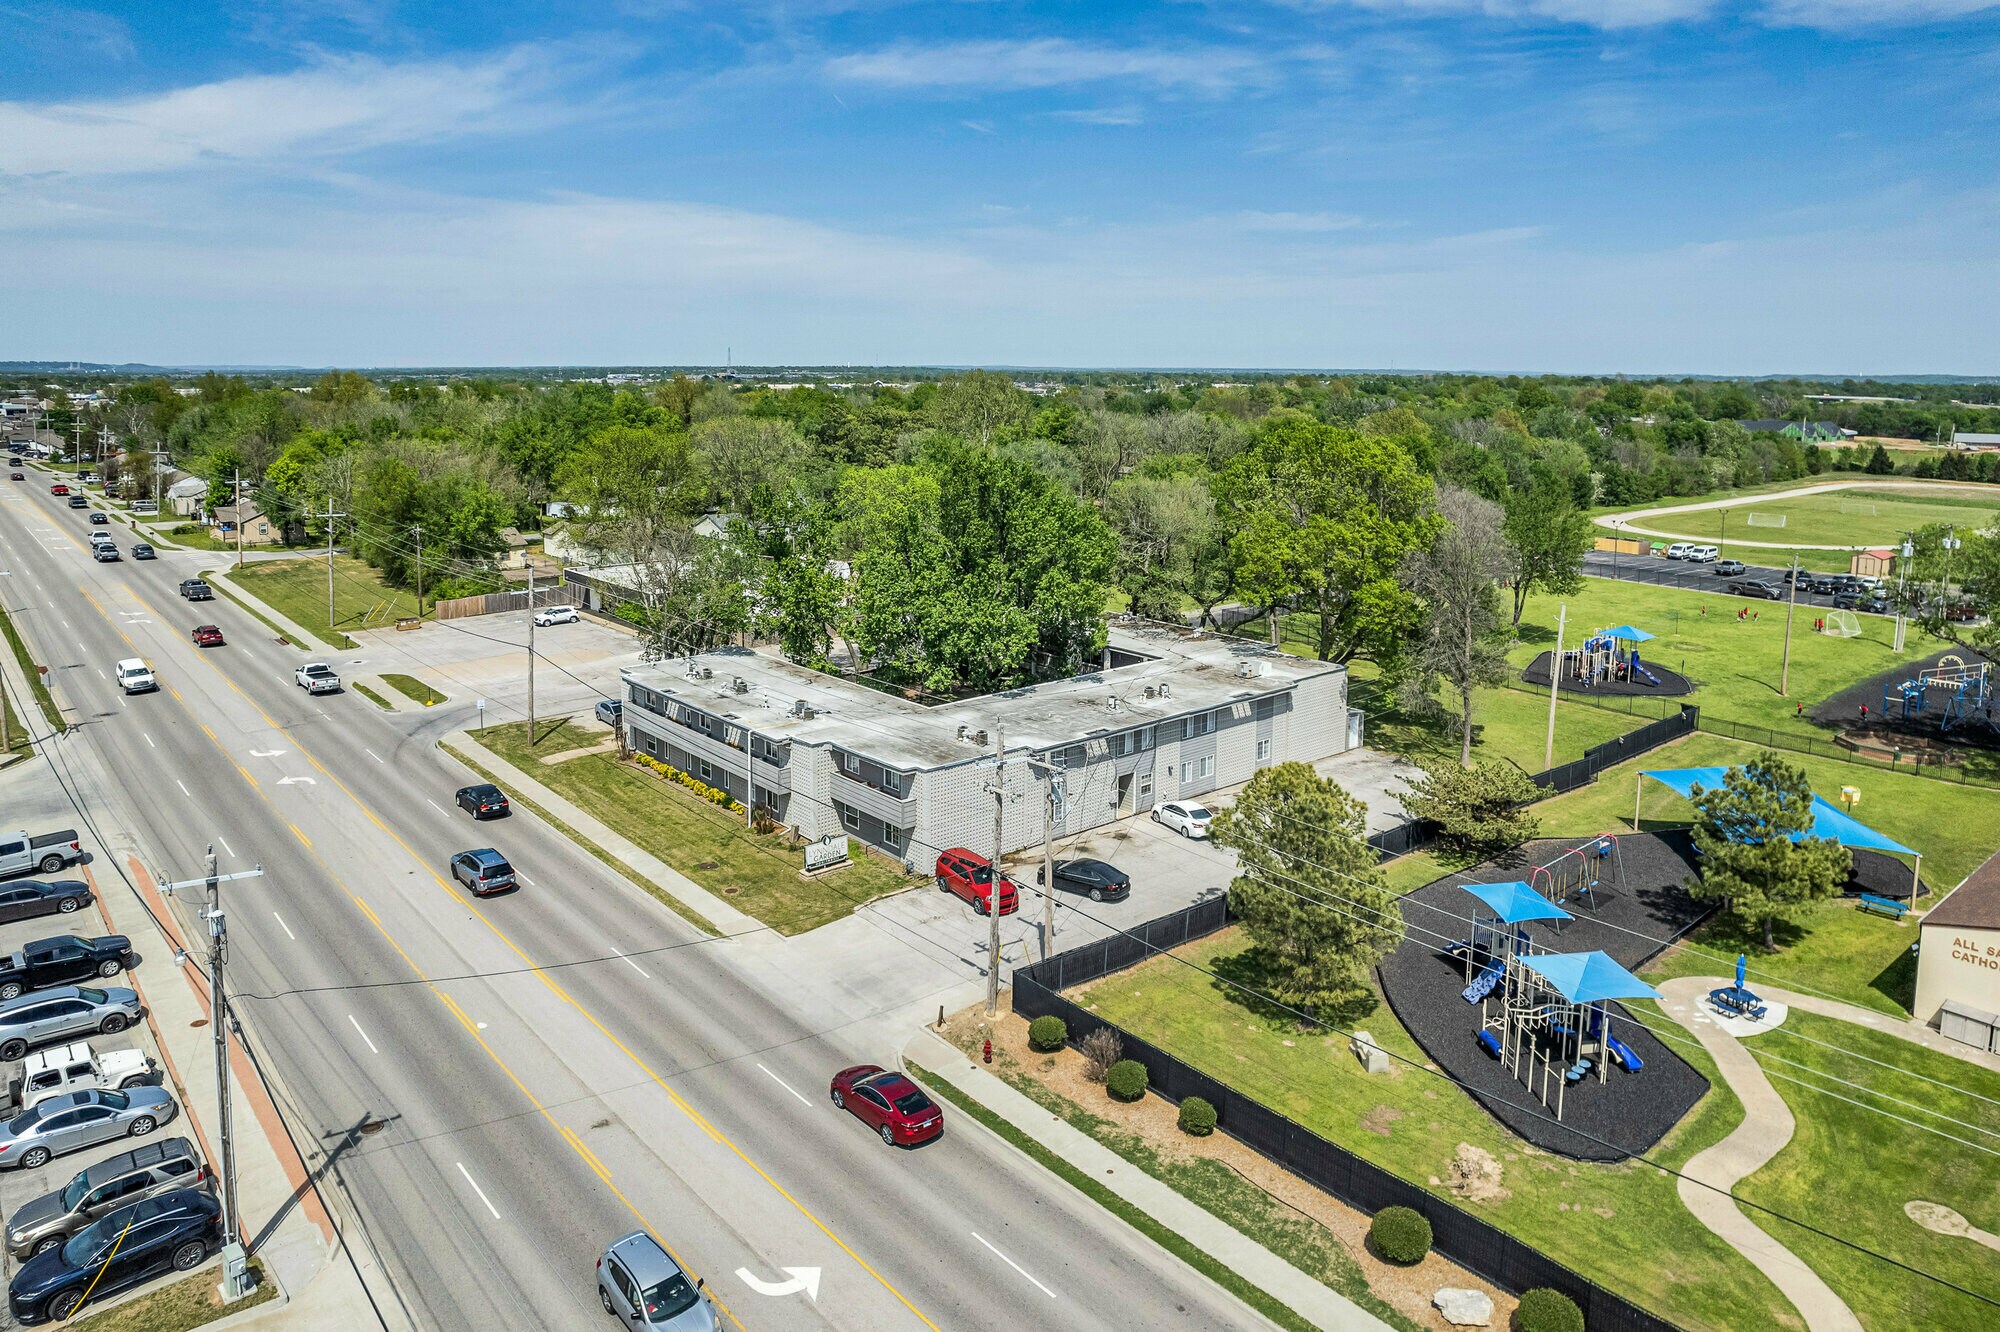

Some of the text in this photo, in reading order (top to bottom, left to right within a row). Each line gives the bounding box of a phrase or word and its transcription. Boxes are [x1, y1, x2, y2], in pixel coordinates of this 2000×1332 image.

[813, 849, 841, 862] GARDEN
[1953, 937, 1979, 952] ALL
[1952, 950, 2000, 971] CATHO
